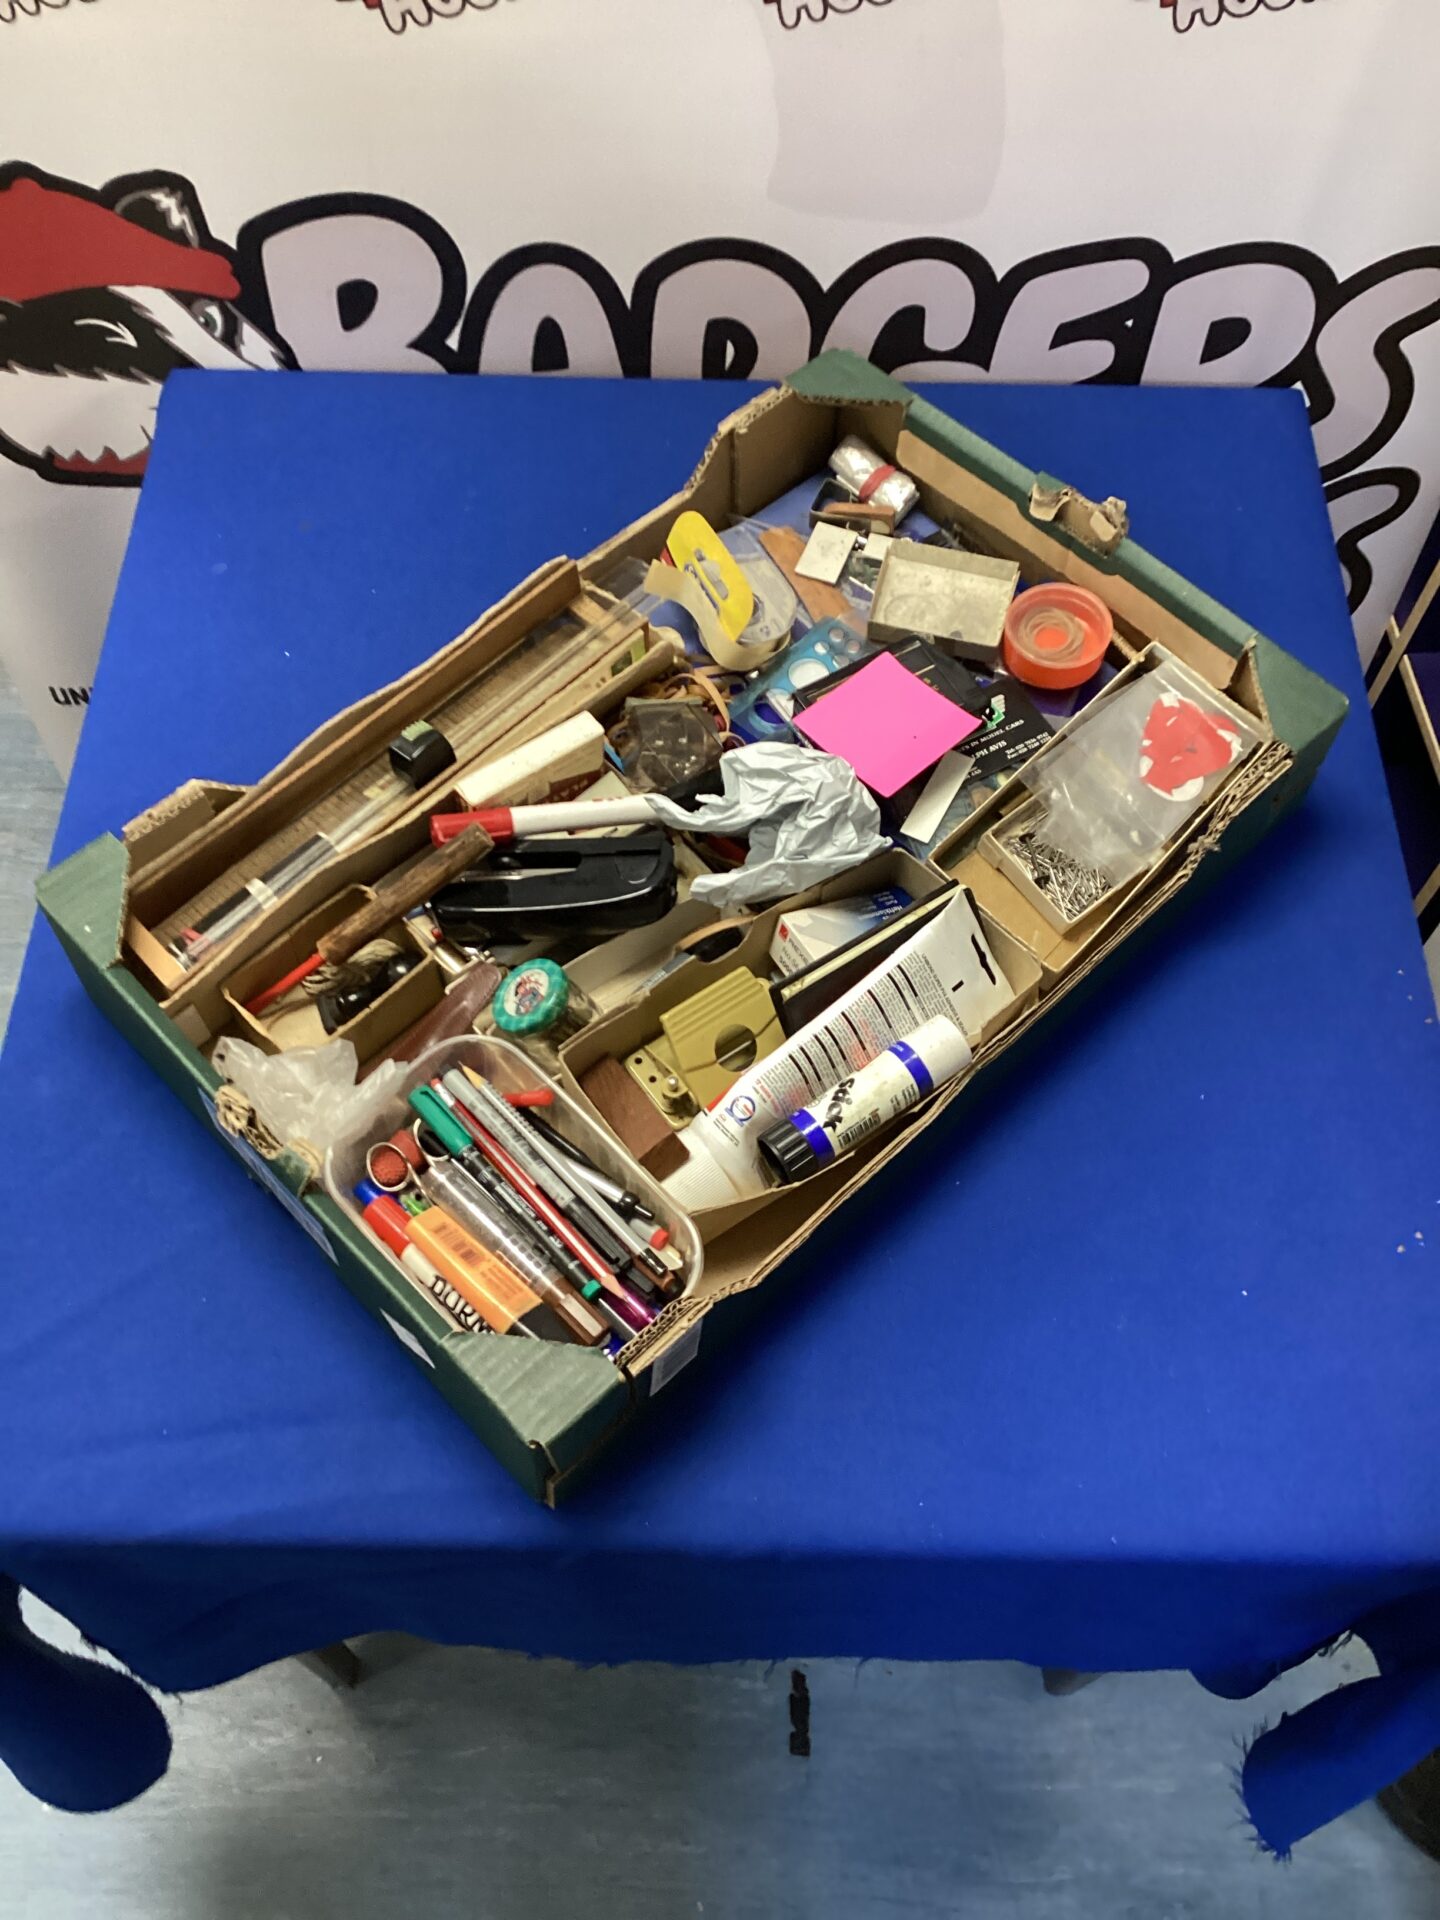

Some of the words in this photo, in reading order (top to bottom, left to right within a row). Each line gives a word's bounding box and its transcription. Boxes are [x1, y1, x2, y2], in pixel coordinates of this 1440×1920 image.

[48, 685, 93, 706] UN
[980, 728, 1005, 743] MODEL
[1005, 719, 1025, 731] CARS
[989, 740, 1007, 753] AVIS
